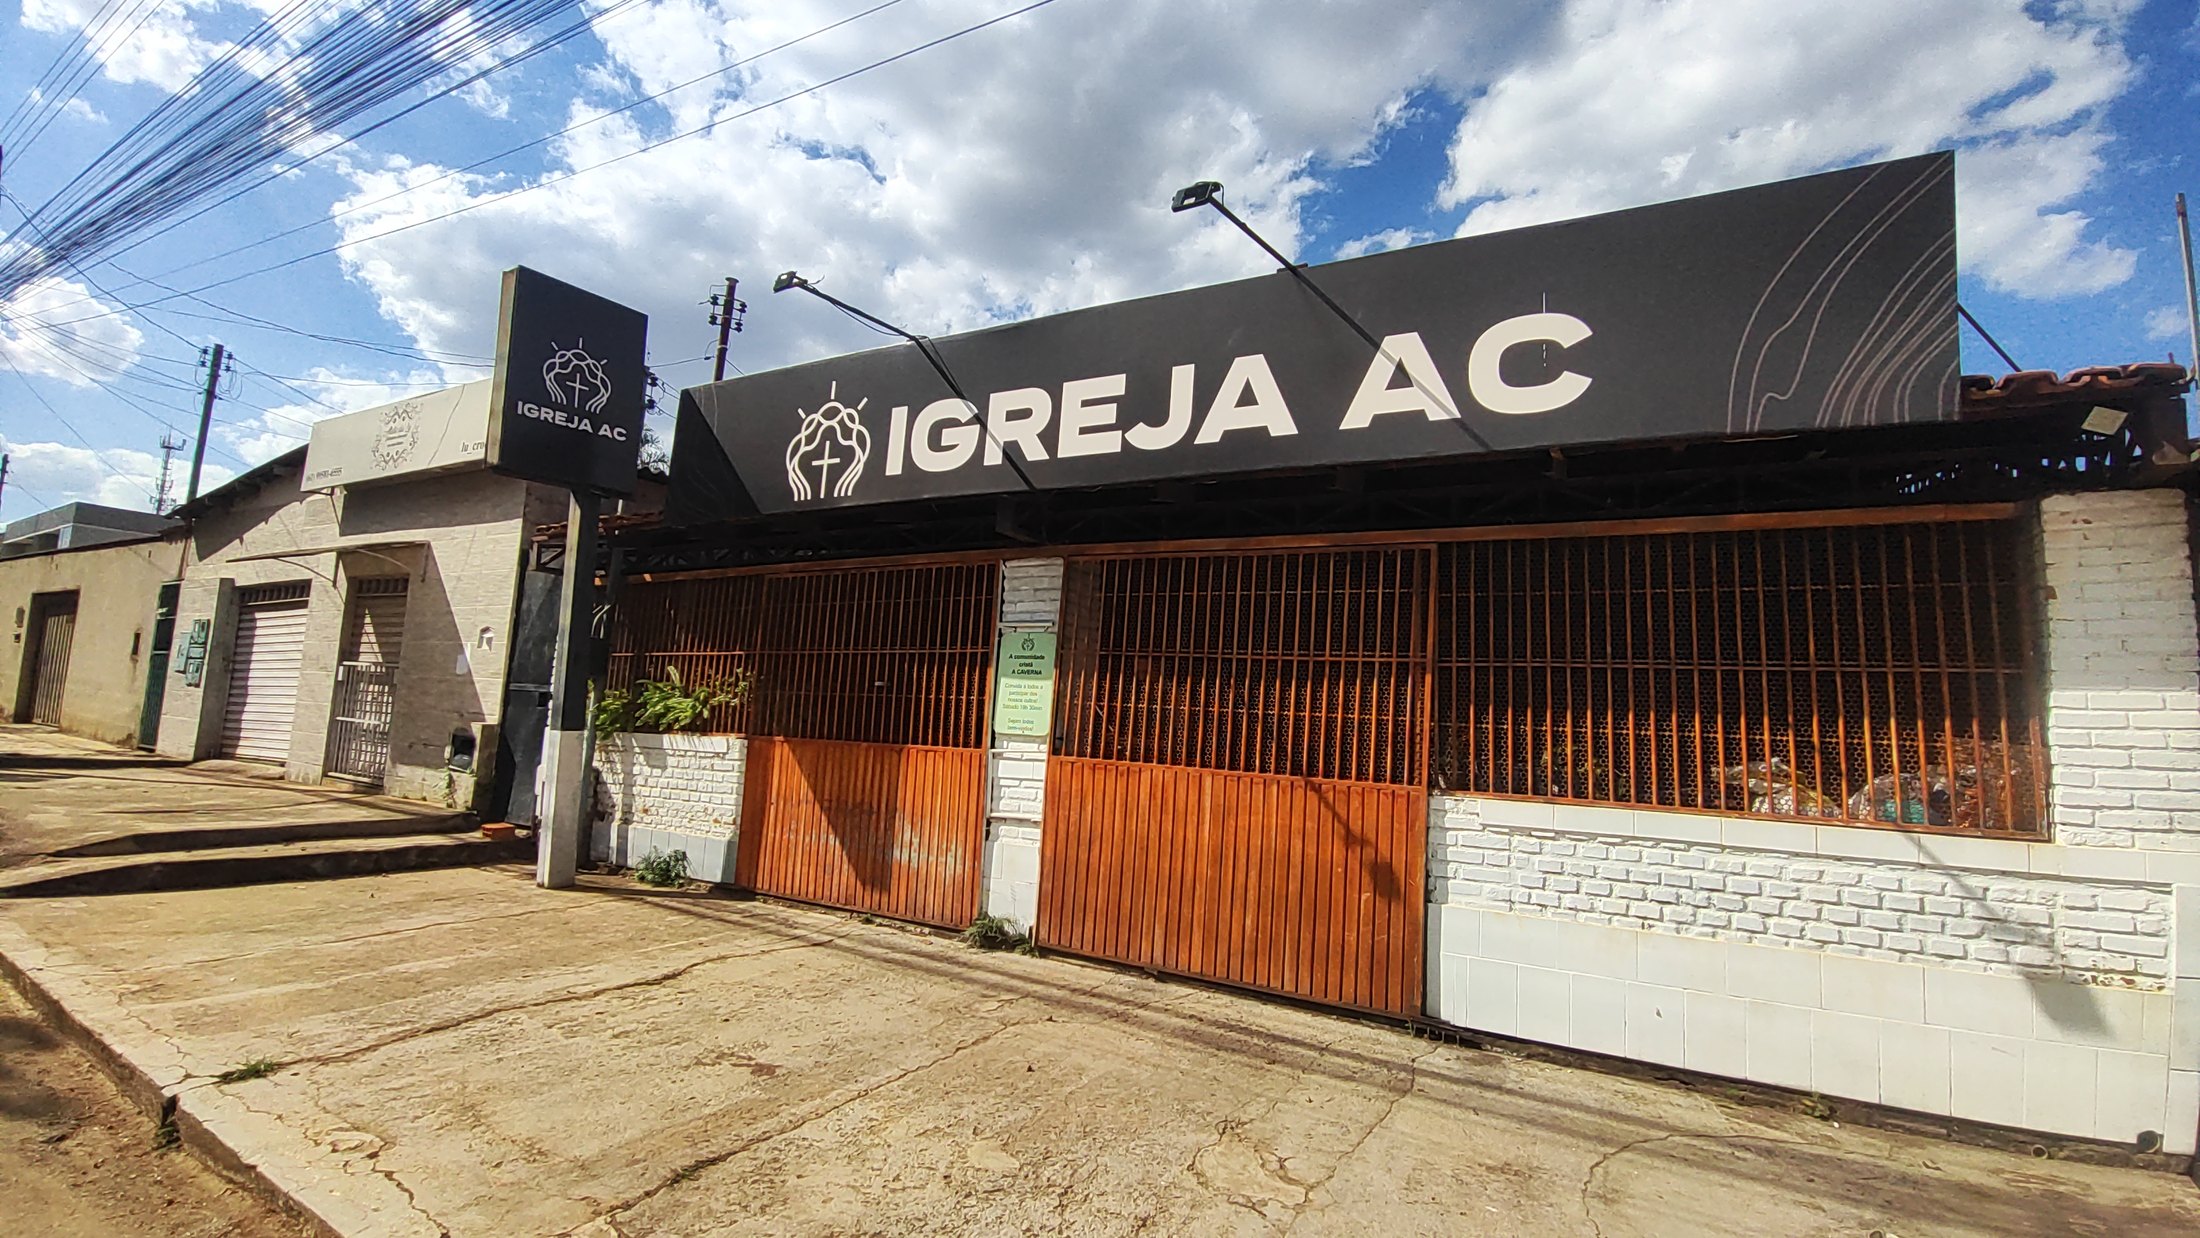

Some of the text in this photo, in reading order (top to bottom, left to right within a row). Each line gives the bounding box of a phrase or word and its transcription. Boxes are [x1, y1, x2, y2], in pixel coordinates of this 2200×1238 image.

[517, 400, 627, 442] IGREJA AC
[884, 312, 1594, 477] IGREJA AC
